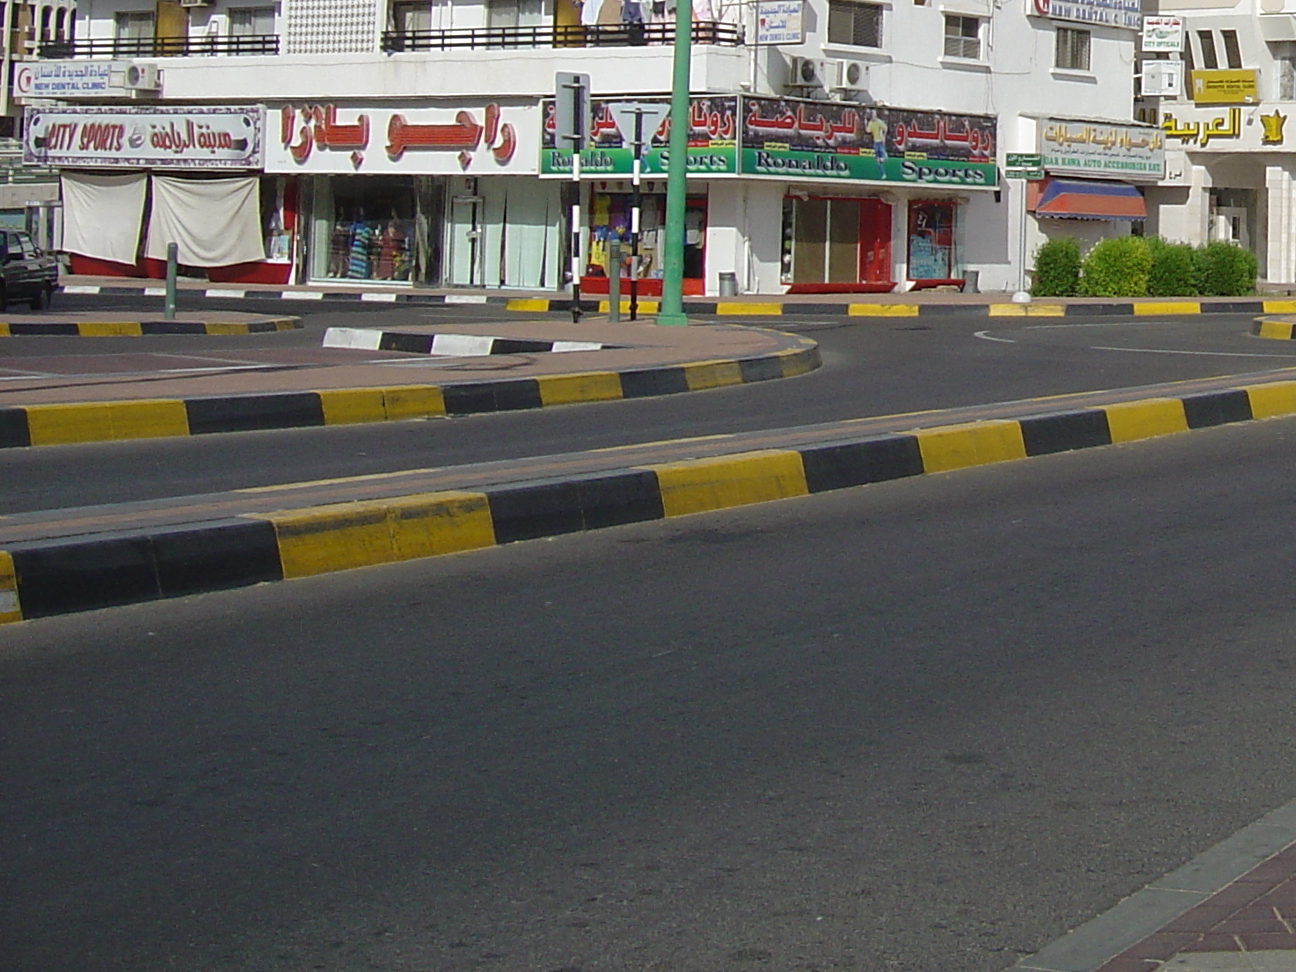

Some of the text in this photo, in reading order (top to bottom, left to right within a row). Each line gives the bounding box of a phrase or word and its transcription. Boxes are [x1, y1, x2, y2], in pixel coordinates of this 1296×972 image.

[51, 82, 80, 90] DENTAL
[82, 82, 106, 90] CLINIC
[45, 123, 125, 152] CITY SPORTS
[659, 150, 728, 171] Sorts
[755, 151, 985, 182] Ronaldo Sports
[1083, 158, 1103, 168] AUTO
